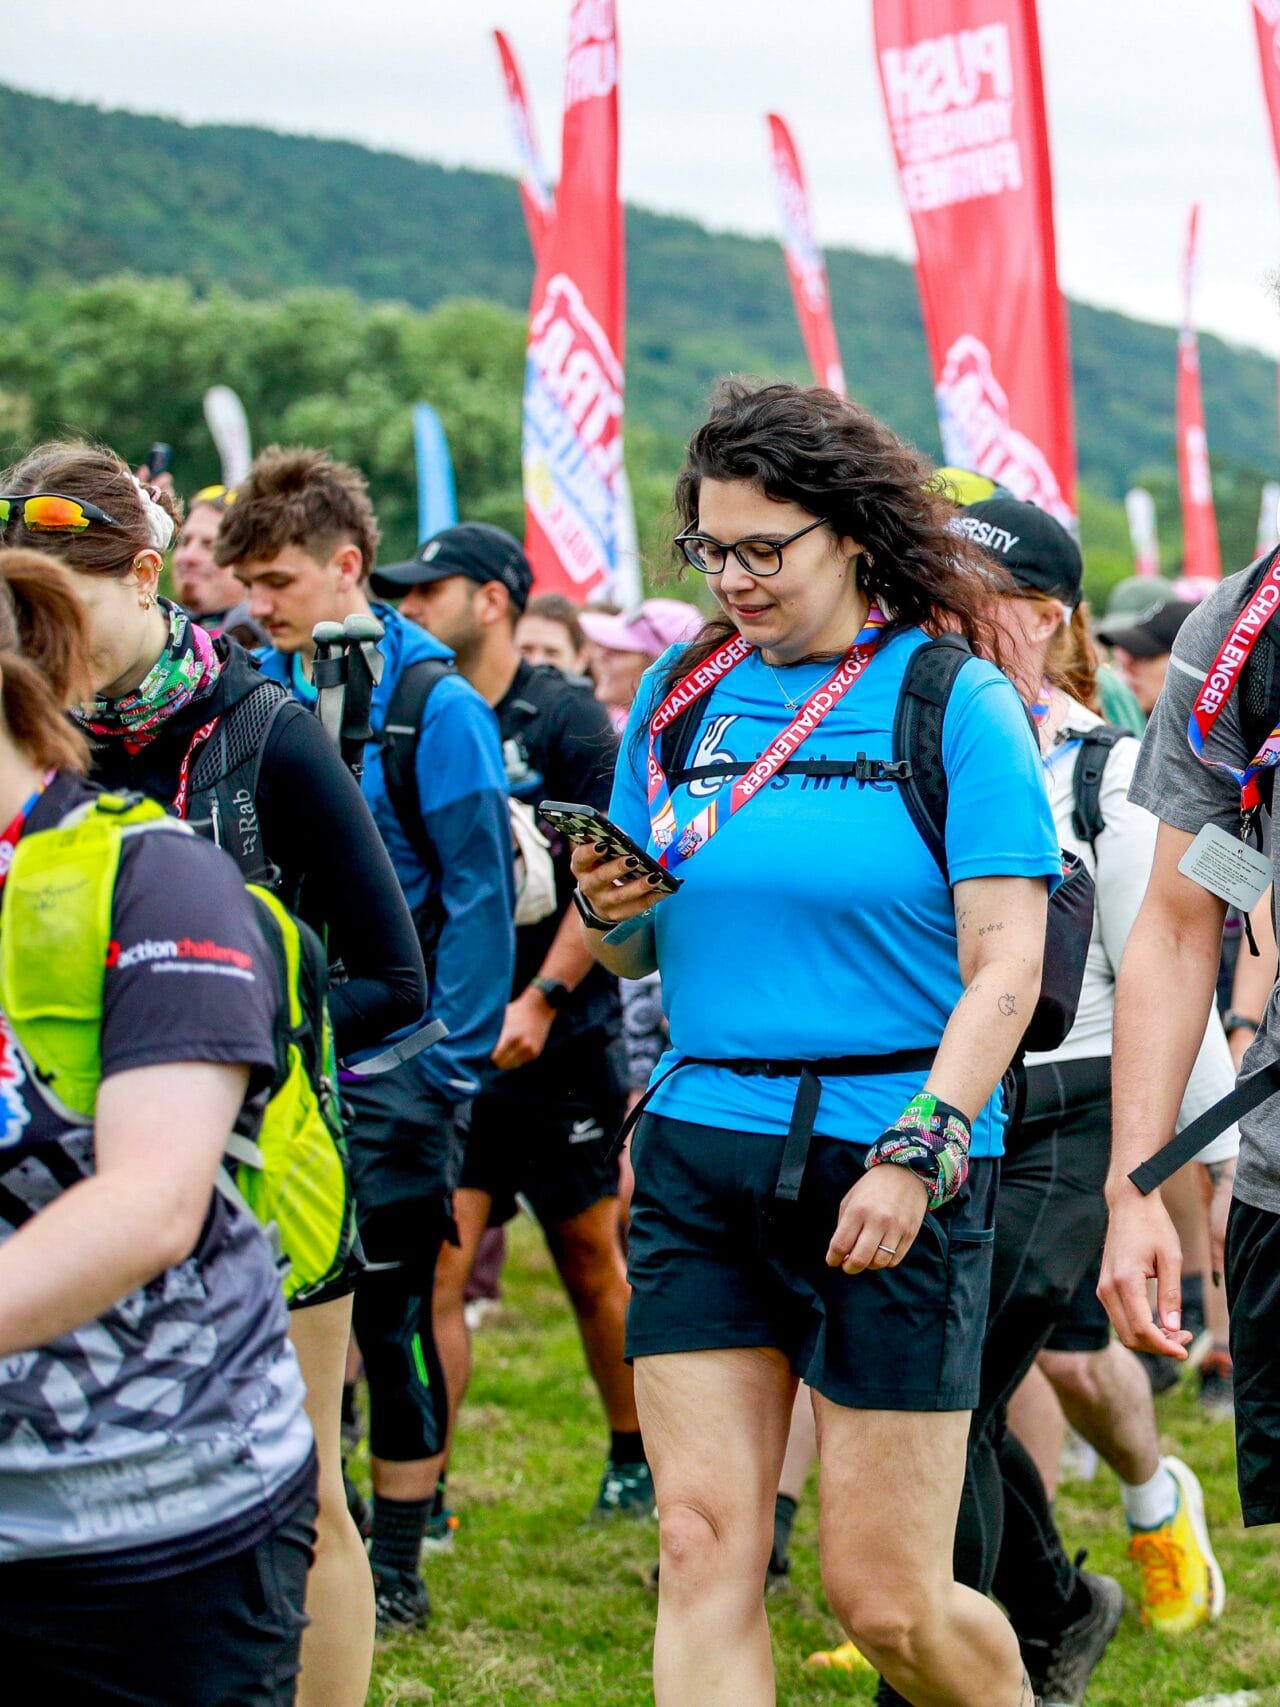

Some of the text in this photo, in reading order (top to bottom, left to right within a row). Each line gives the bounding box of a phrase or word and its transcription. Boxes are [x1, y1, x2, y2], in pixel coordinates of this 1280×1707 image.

[652, 636, 753, 731] CHALLENGER
[828, 646, 869, 694] 2026
[1197, 584, 1279, 715] CHALLENGER
[735, 692, 833, 796] CHALLENGER
[233, 788, 259, 834] Rab
